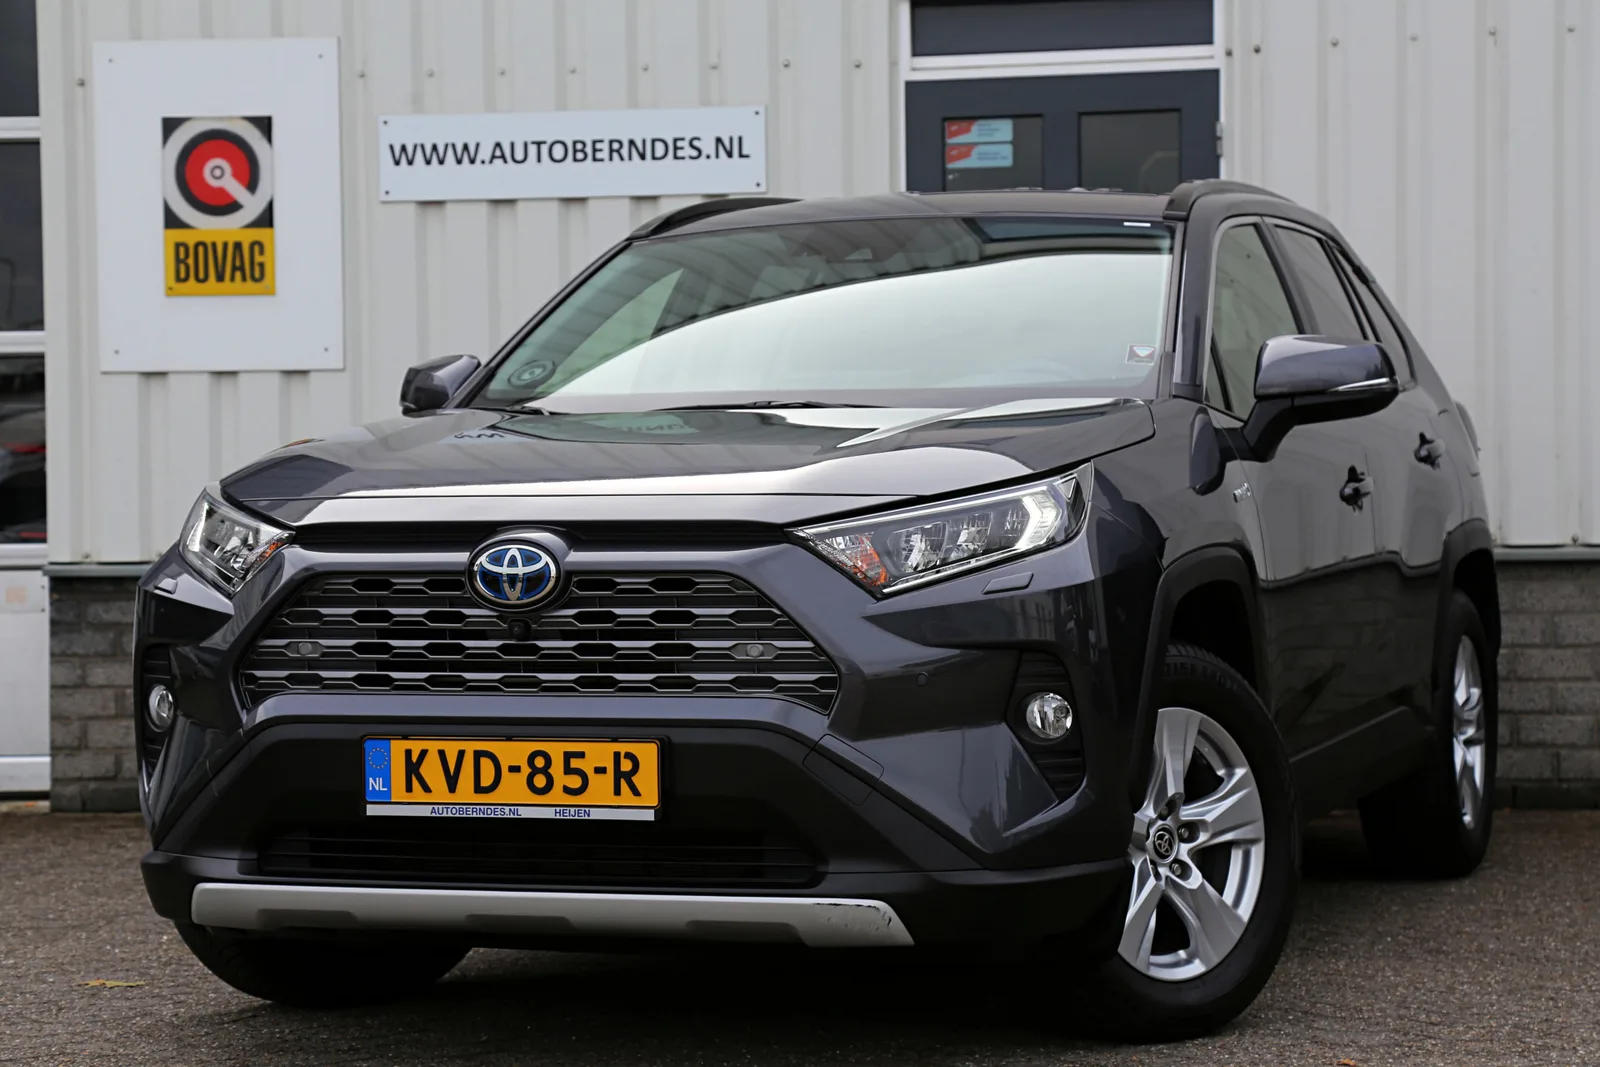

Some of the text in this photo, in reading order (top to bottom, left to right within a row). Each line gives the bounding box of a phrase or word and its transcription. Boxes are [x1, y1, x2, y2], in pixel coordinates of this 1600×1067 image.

[389, 136, 751, 167] WWW.AUTOBERNDES.NL
[173, 240, 265, 284] BOVAG
[369, 777, 388, 791] NL
[404, 748, 641, 797] KVD-85-R
[430, 806, 591, 819] AUTOBERNDES.NL HEIJEN
